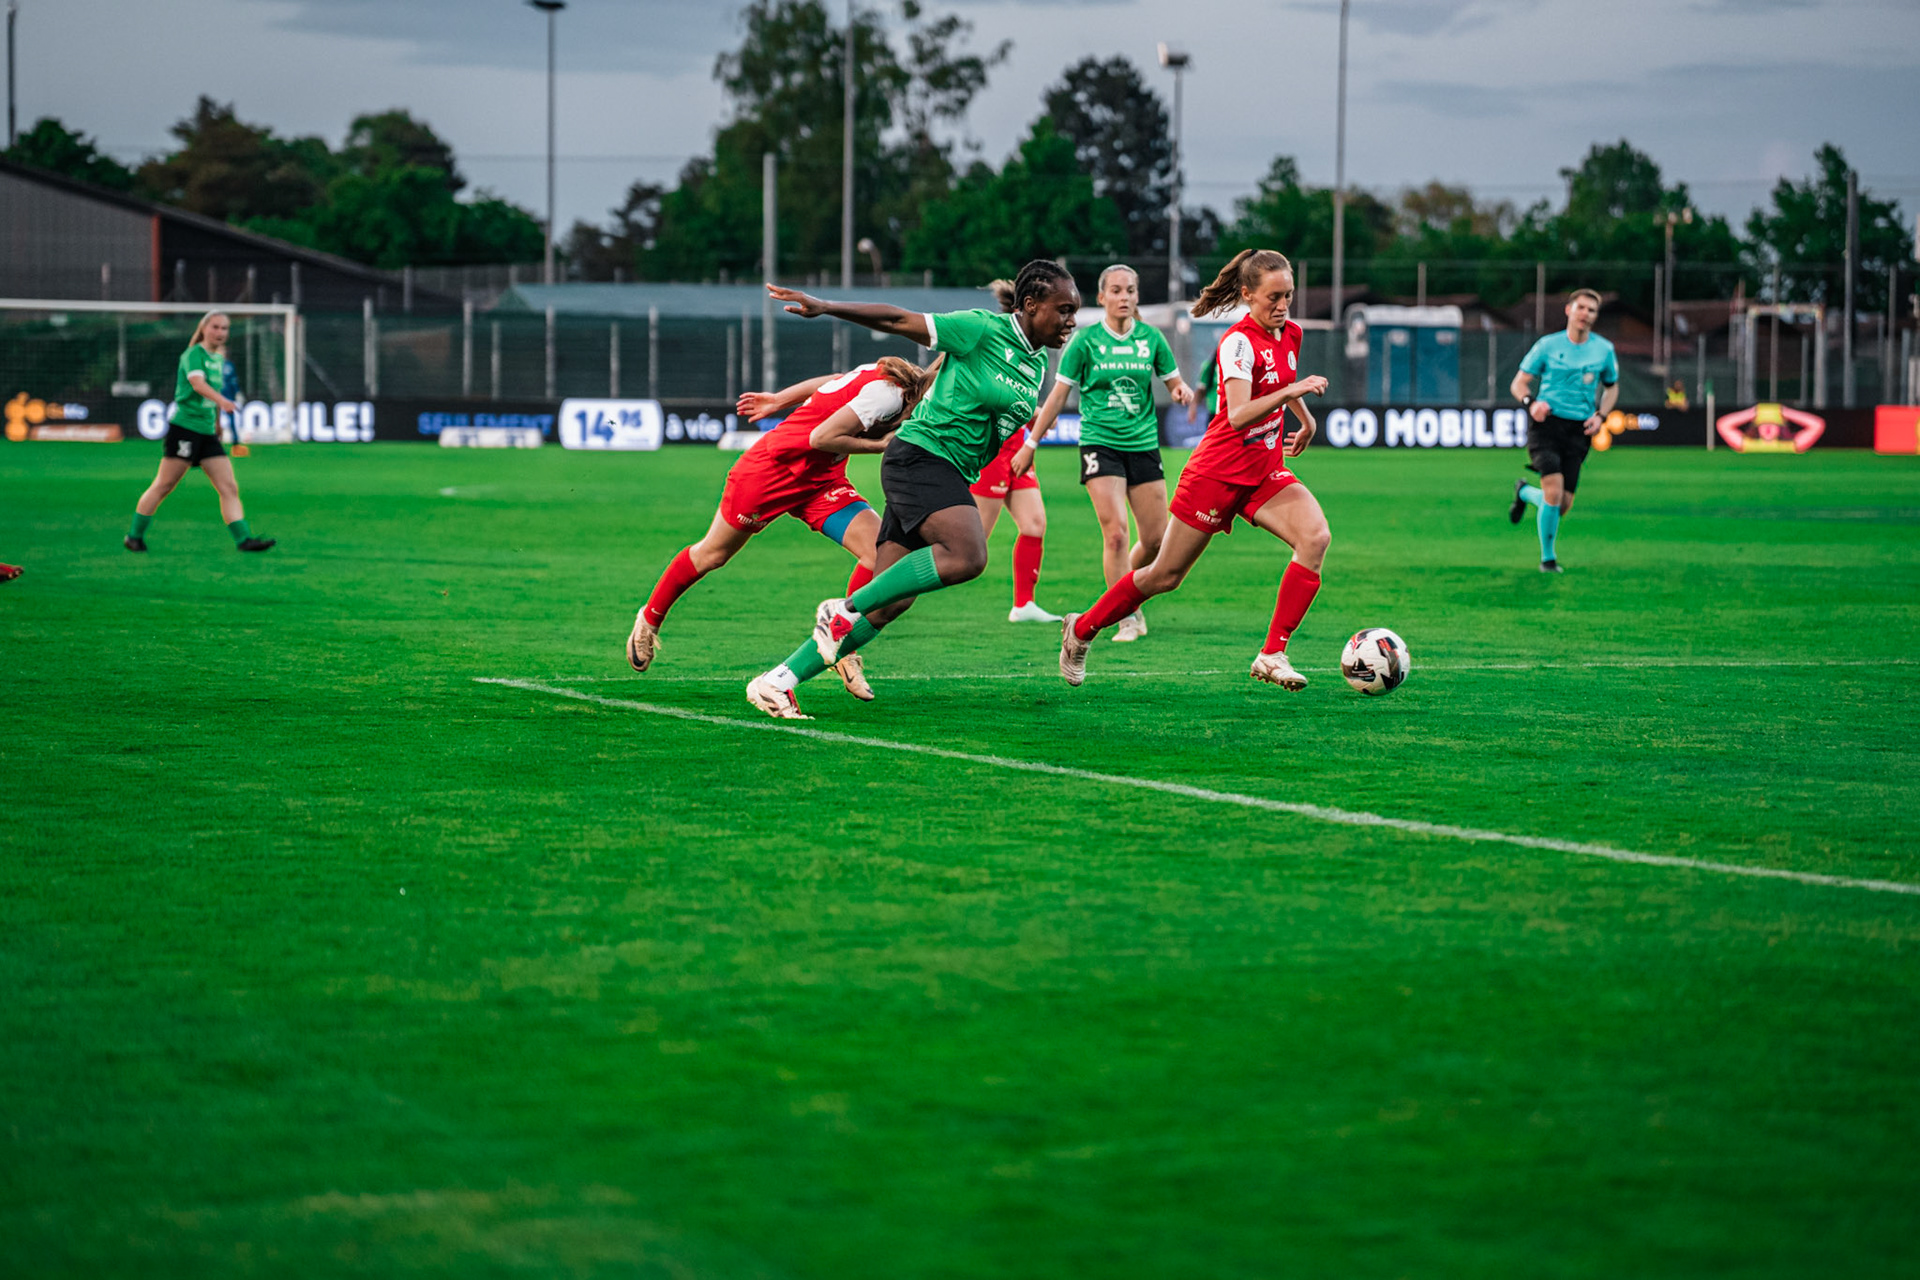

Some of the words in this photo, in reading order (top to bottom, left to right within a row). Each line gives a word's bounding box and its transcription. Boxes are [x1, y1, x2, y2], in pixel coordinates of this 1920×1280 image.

[137, 398, 180, 441] G
[1326, 408, 1378, 448] GO
[1384, 408, 1528, 448] MOBILE!
